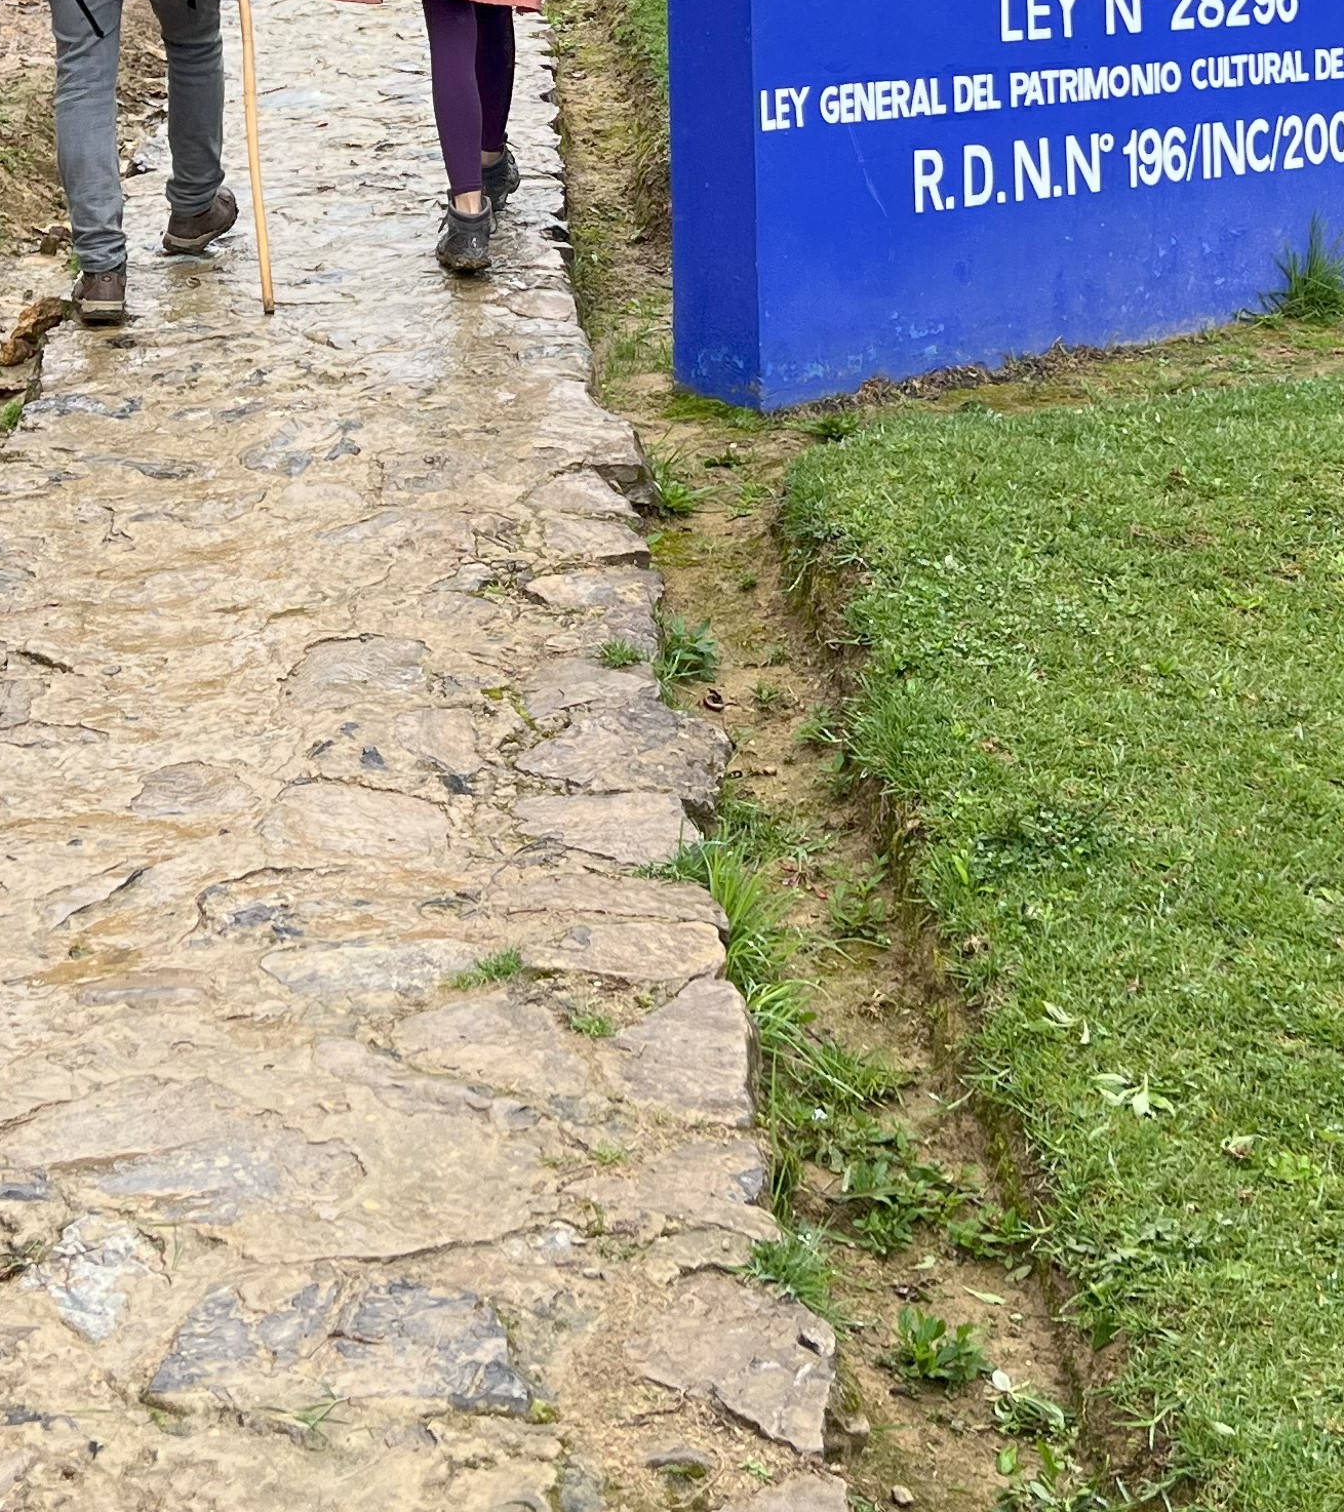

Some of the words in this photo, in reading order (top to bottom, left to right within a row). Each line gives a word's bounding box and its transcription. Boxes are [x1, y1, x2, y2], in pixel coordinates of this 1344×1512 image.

[759, 85, 811, 133] LEY
[819, 76, 947, 124] GENERAL
[952, 73, 1002, 114] DEL
[1009, 60, 1183, 108] PATRIMONIO
[1190, 50, 1310, 91] CULTURAL
[1314, 47, 1344, 81] DE
